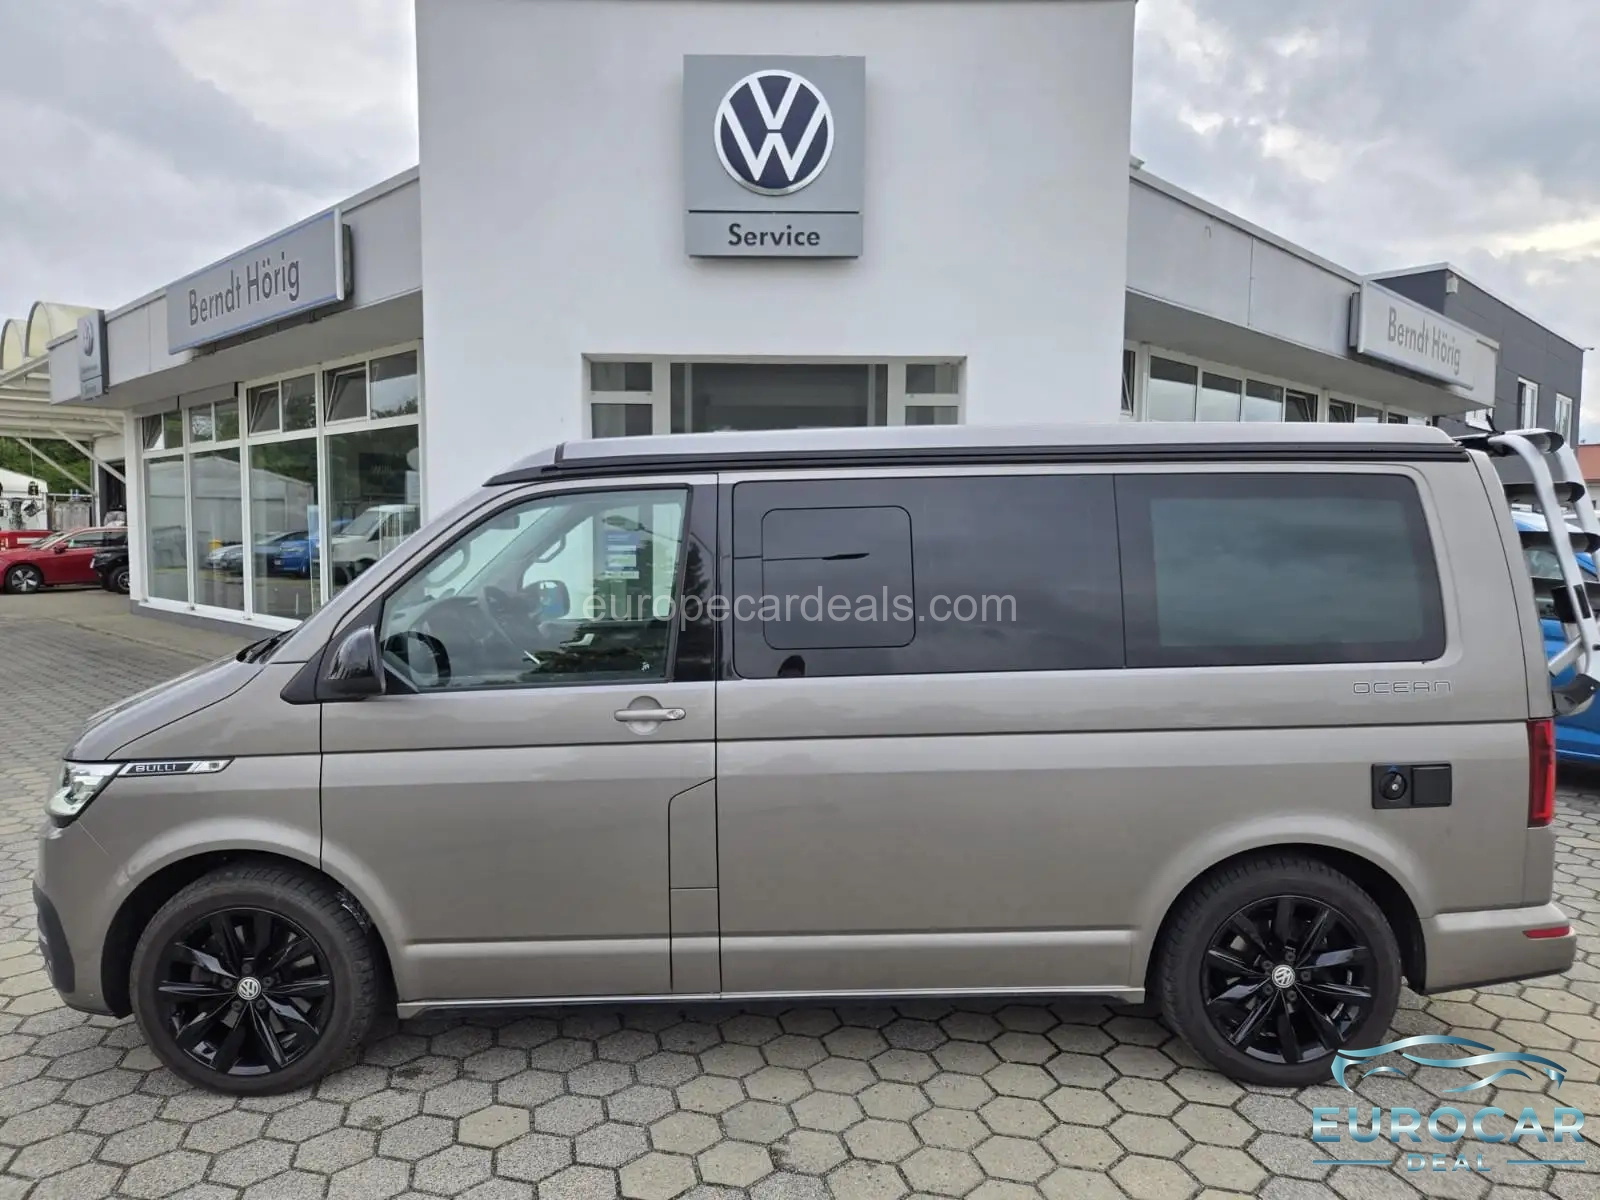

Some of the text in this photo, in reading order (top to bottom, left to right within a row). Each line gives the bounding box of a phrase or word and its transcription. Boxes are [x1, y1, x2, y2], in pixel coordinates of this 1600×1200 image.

[728, 223, 820, 246] Service
[189, 252, 300, 326] Berndt Hörig
[1388, 308, 1461, 375] Berndt Hörig
[1353, 681, 1451, 694] OCEAN
[135, 764, 176, 772] BULLI
